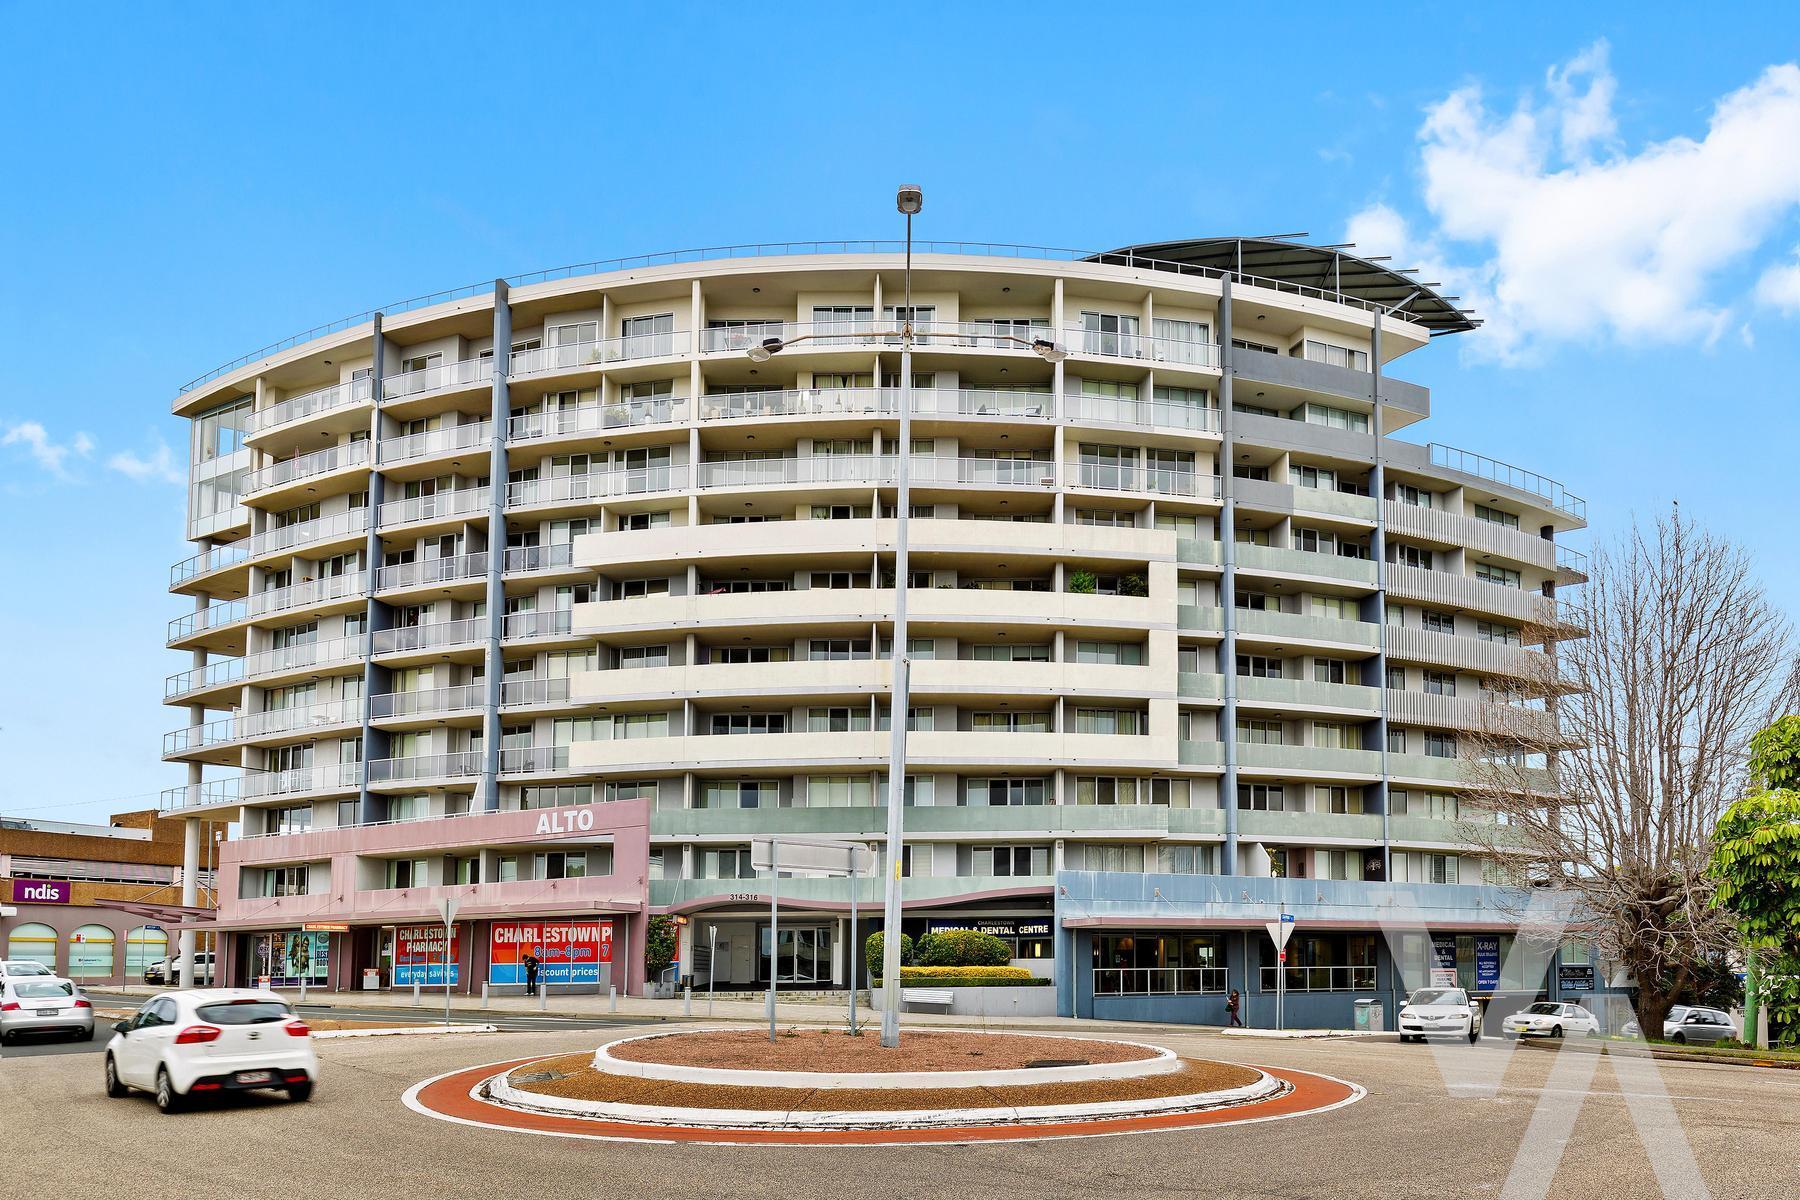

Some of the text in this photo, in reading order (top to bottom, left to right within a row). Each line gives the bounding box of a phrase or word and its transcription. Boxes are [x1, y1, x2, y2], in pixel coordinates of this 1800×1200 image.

[536, 809, 593, 834] ALTO
[24, 883, 59, 900] ndis
[495, 927, 598, 942] CHARLESTOWN
[981, 926, 1015, 935] DENTAL
[1018, 925, 1049, 934] CENTRE
[602, 944, 609, 957] 7
[1478, 942, 1497, 950] X-RAY
[538, 967, 598, 978] iscount prices
